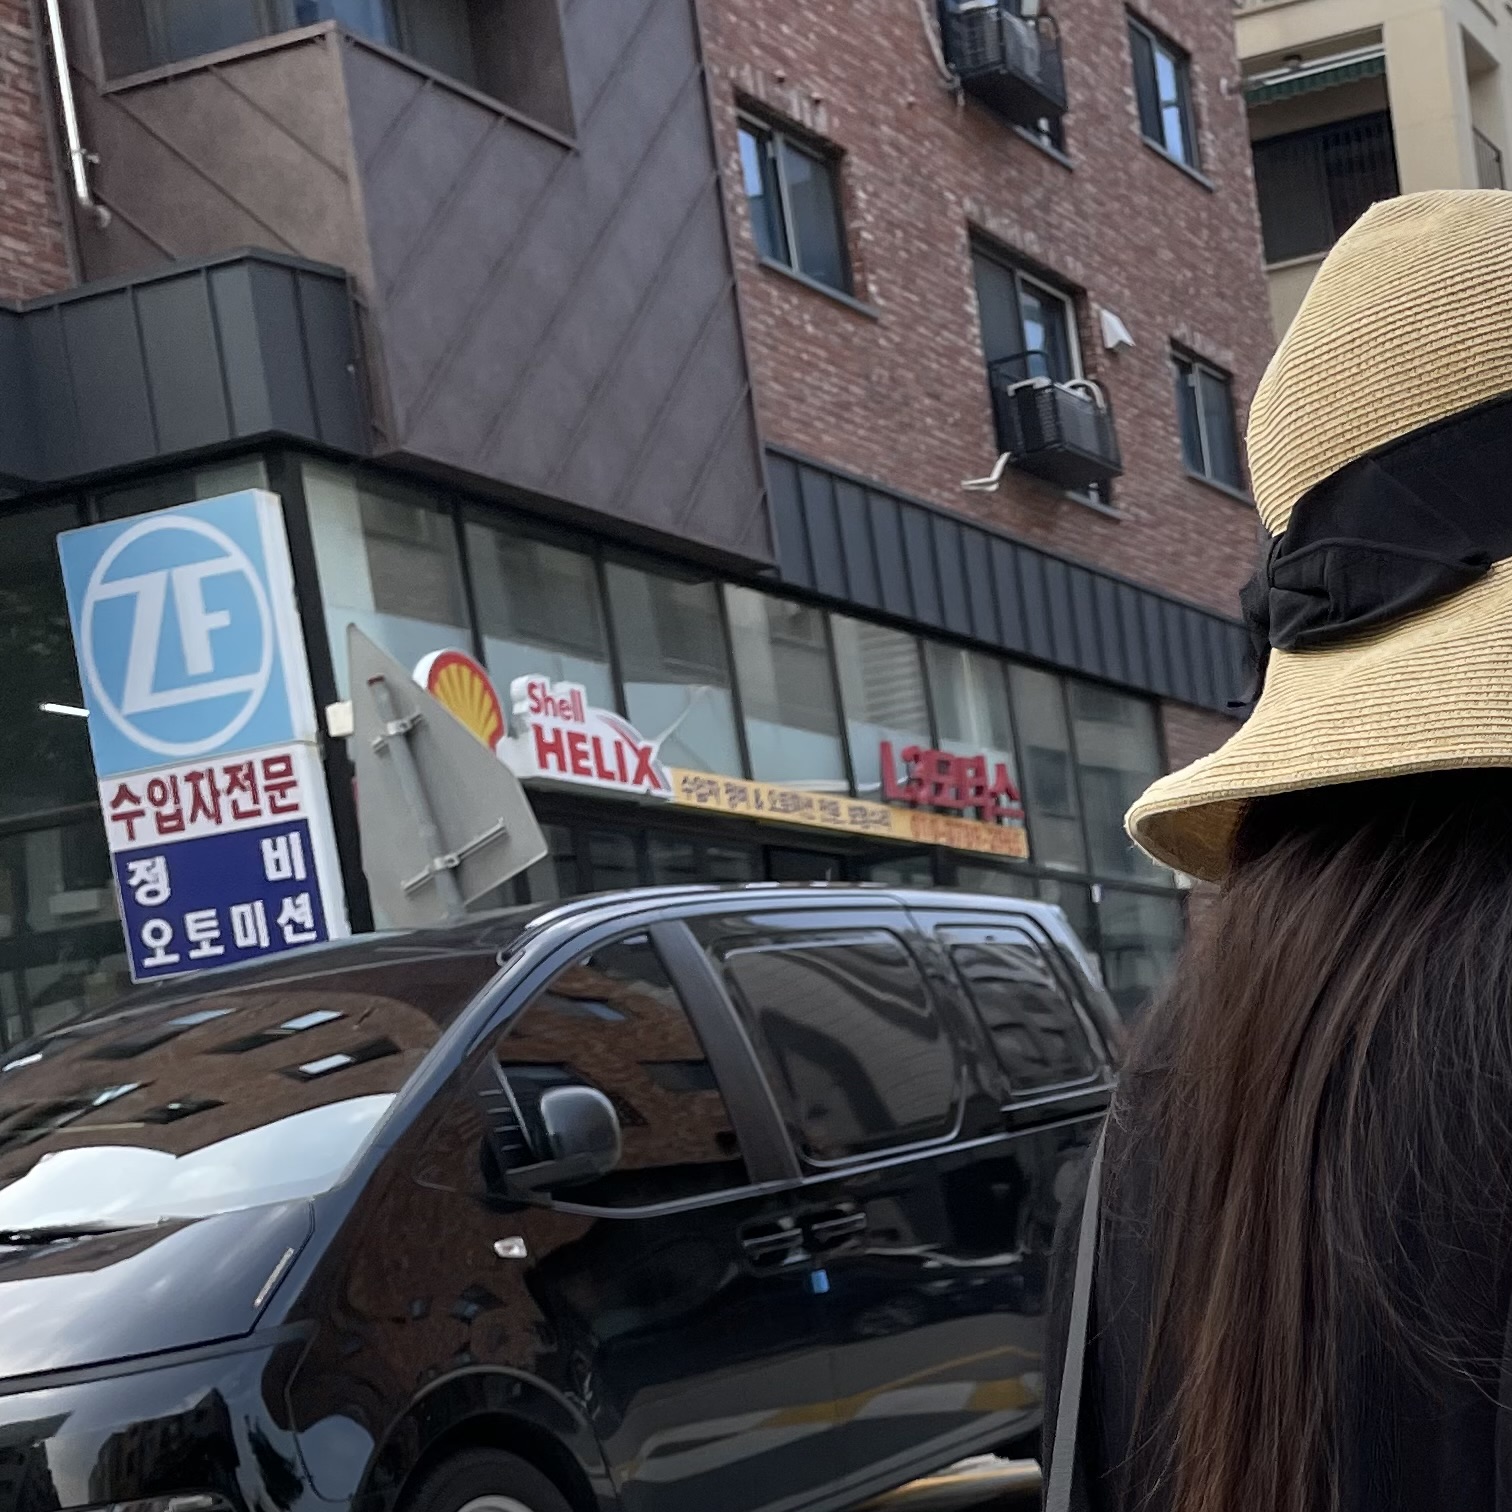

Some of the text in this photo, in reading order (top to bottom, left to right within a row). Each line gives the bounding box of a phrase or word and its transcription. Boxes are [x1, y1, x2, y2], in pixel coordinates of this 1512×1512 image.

[84, 550, 265, 716] ZF
[527, 681, 585, 723] Shell
[533, 722, 661, 790] HELIX
[110, 754, 300, 842] 수입차전문
[140, 892, 318, 968] 오토미션
